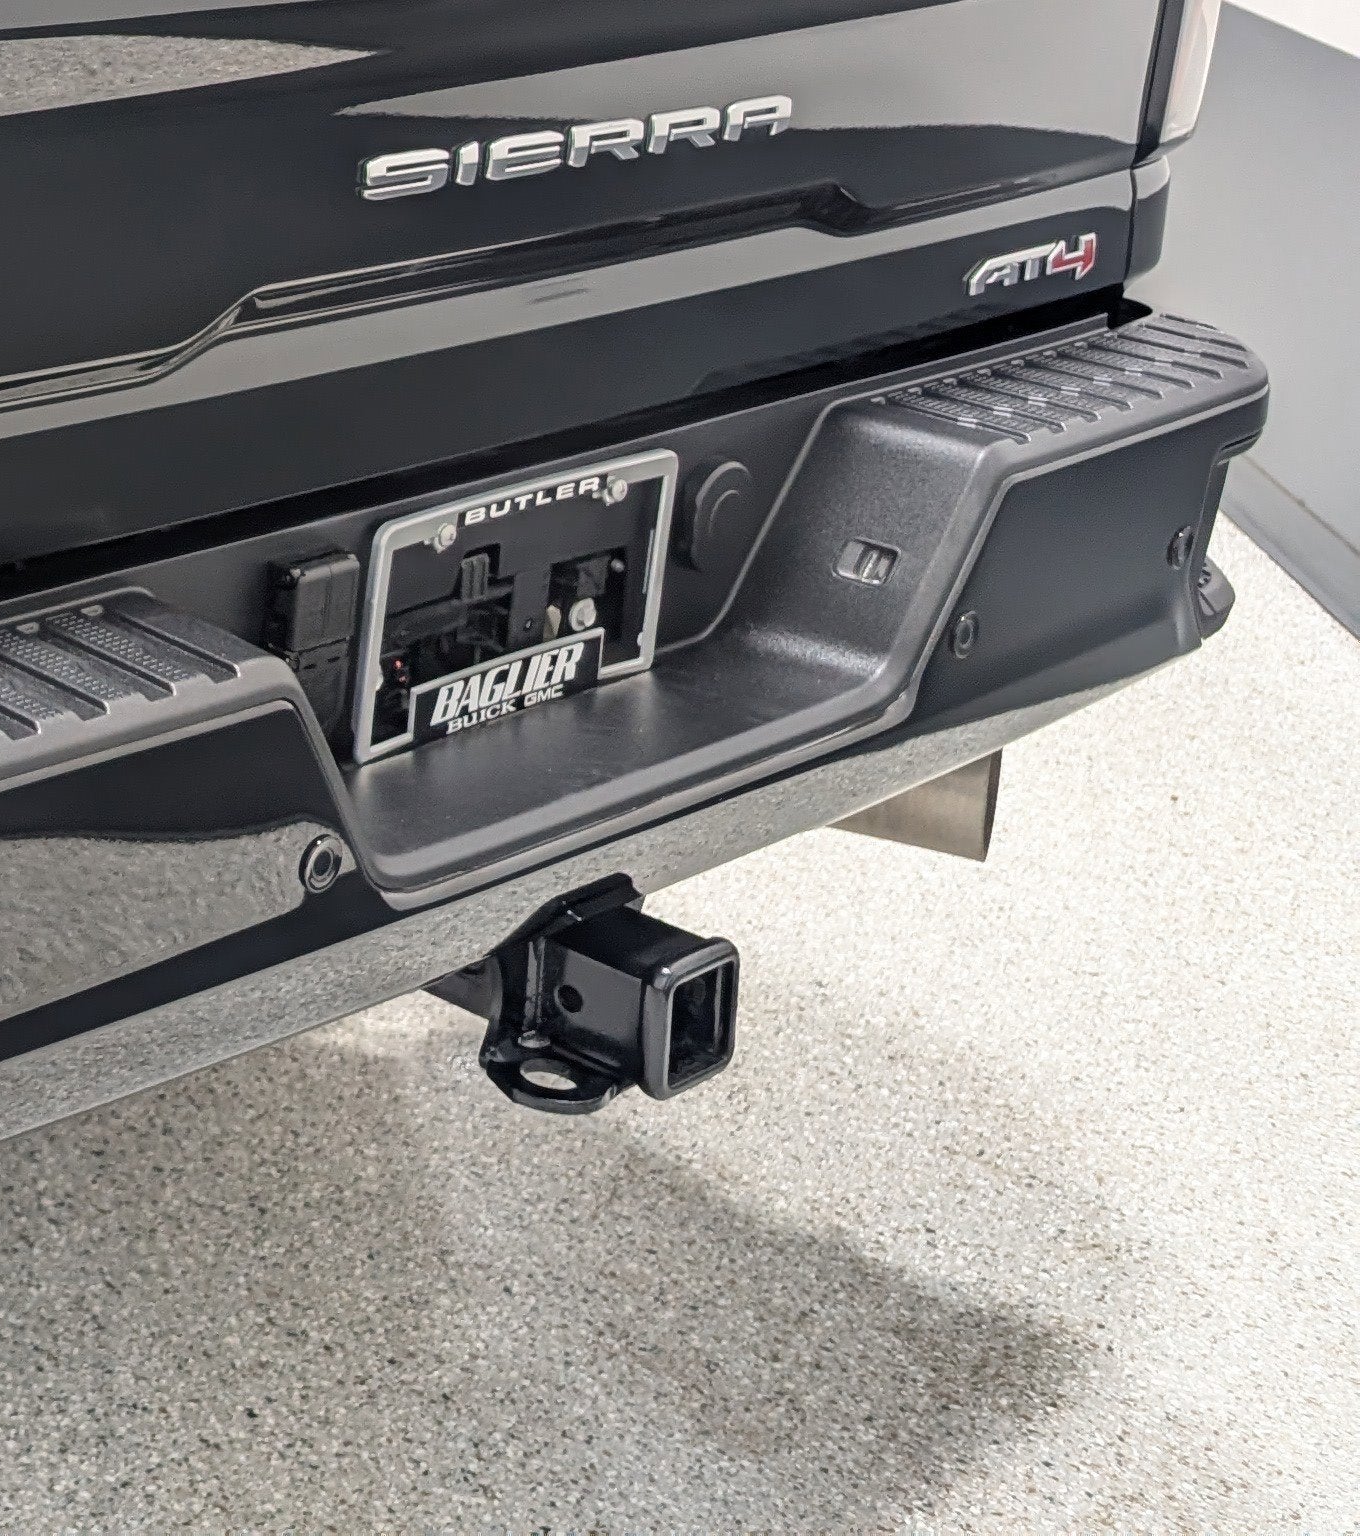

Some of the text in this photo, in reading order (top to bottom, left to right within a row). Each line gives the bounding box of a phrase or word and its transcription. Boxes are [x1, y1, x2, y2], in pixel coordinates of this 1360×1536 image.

[357, 94, 792, 201] SIERRA
[964, 232, 1097, 296] AT4
[464, 477, 600, 526] BUTLER
[430, 642, 584, 726] BAGLIER
[446, 683, 564, 734] BUICK GMC
